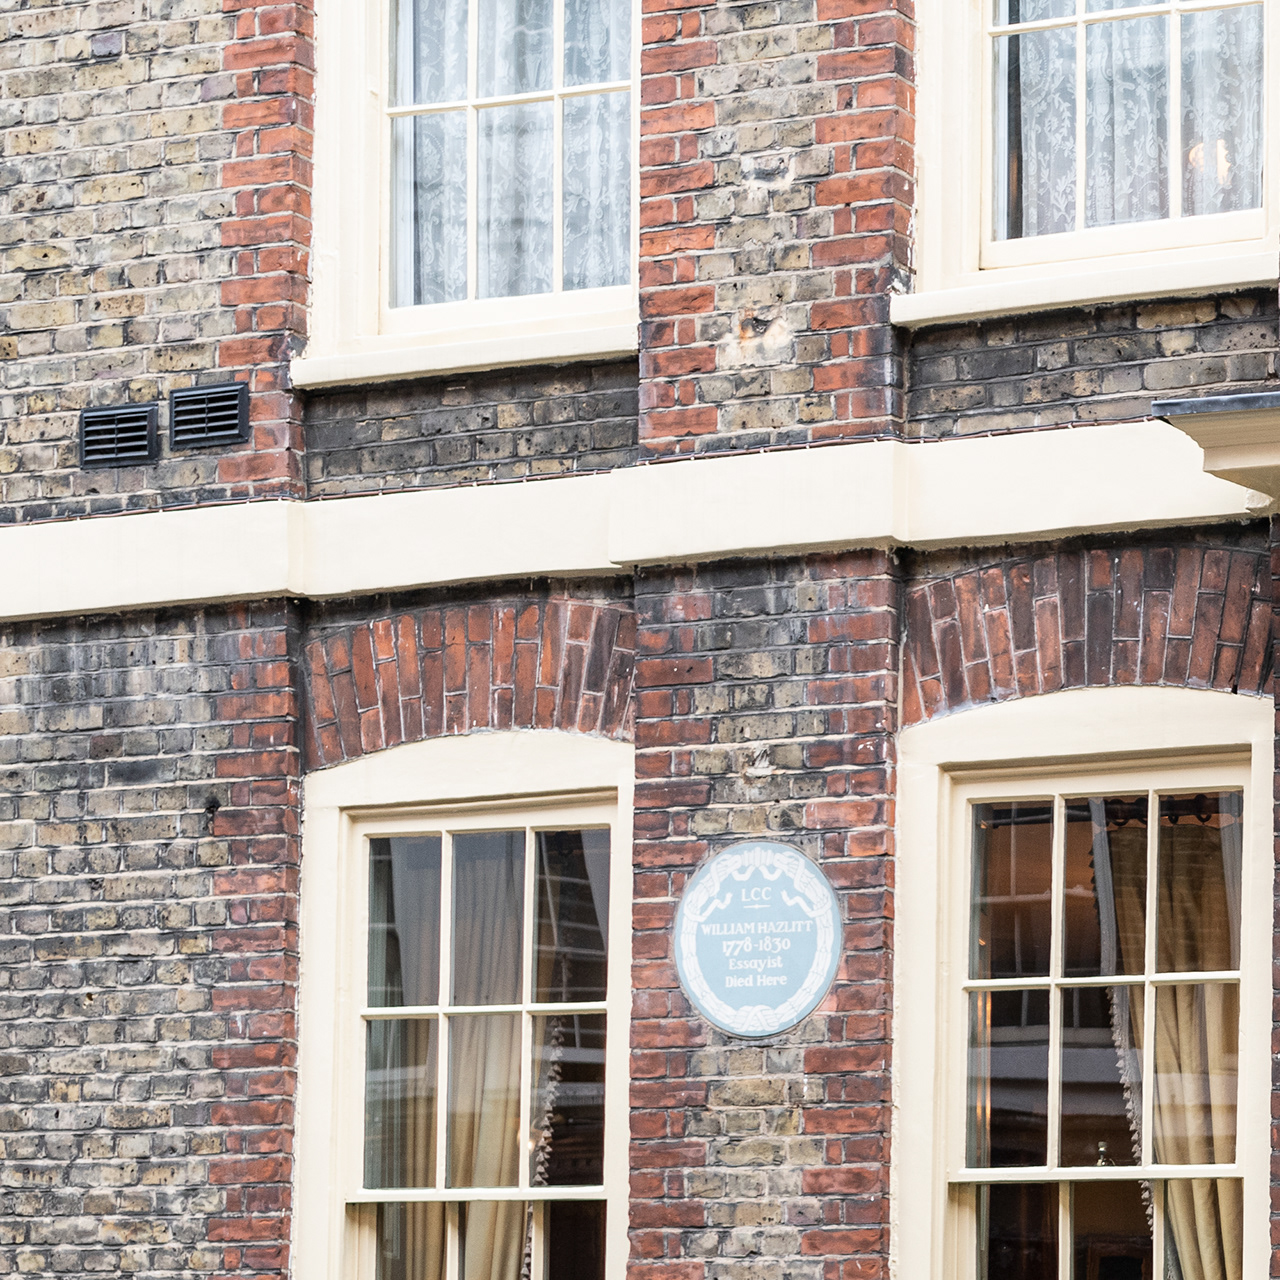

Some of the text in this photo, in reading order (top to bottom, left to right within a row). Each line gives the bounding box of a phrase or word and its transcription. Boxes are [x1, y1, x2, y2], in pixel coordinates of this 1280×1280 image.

[701, 920, 813, 936] WILLIAM HAZLITT
[722, 936, 791, 957] 1778-1830
[729, 955, 783, 972] Essayist
[725, 974, 788, 988] Died Here
